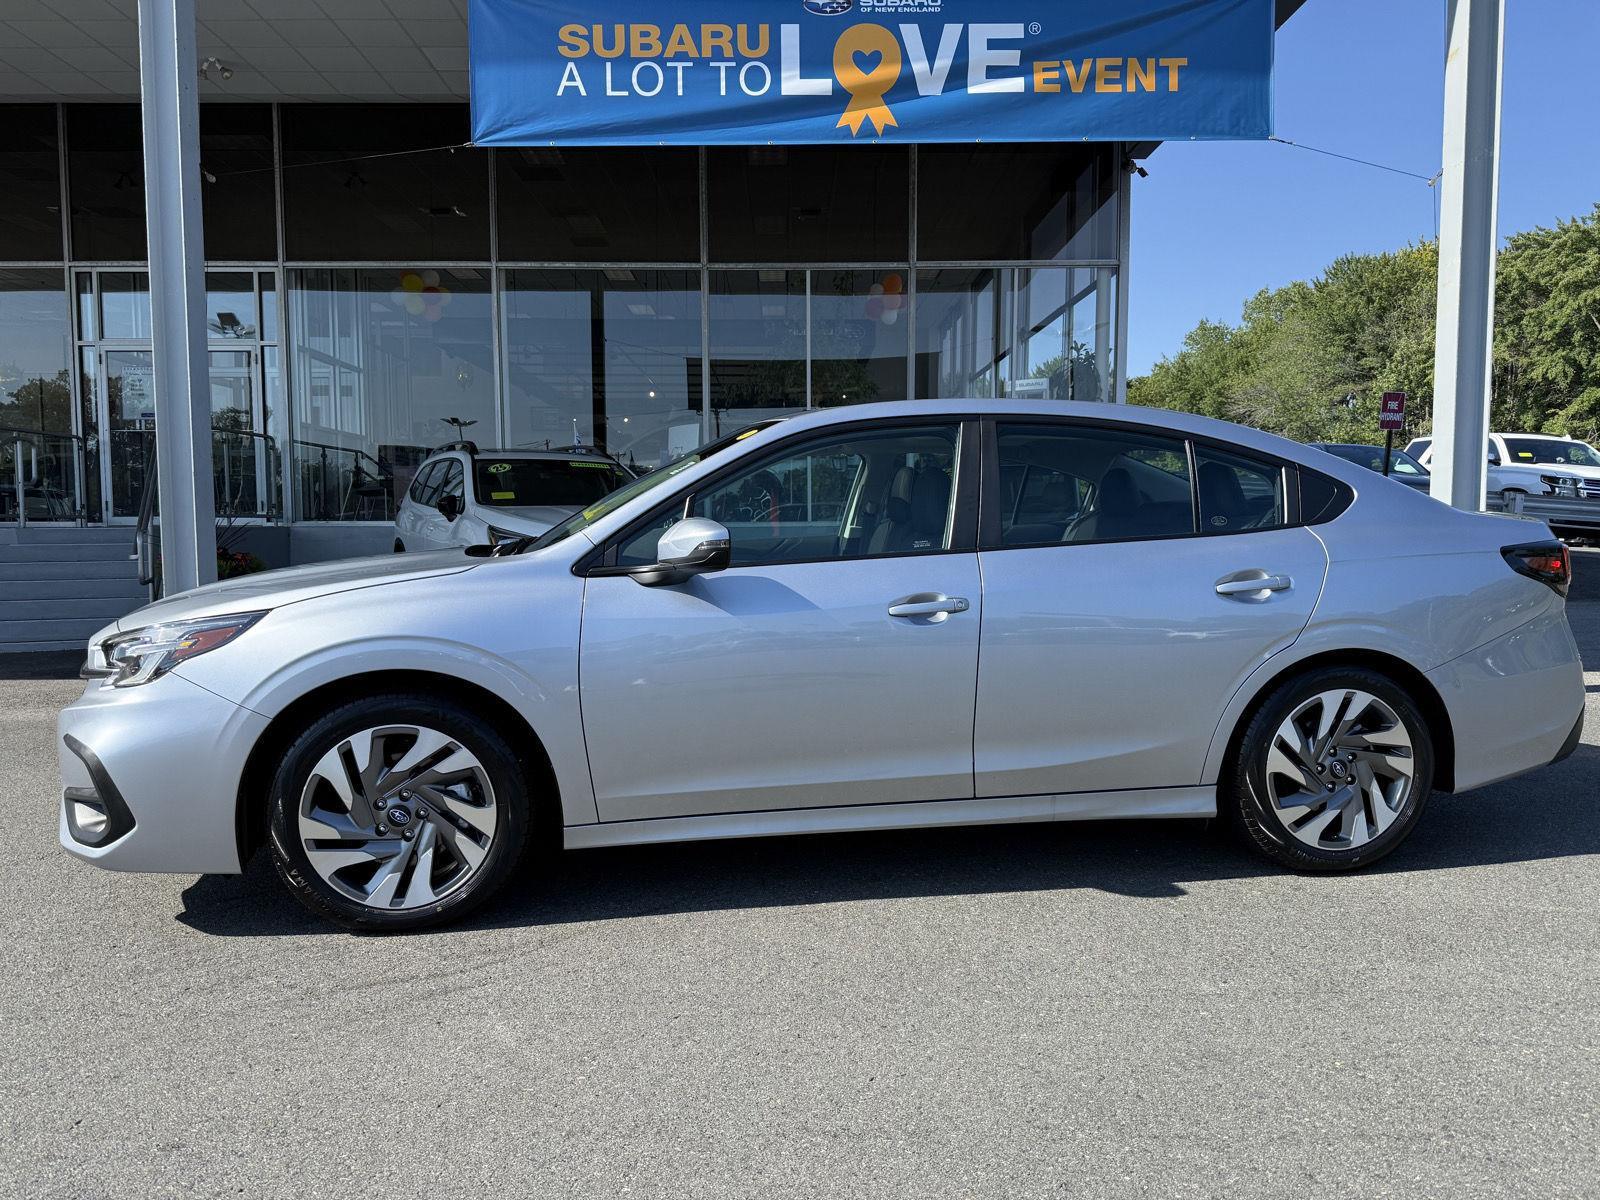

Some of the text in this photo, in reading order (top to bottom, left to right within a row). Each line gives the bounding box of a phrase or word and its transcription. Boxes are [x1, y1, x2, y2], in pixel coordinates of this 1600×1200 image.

[557, 24, 770, 58] SUBARU
[557, 61, 588, 96] A
[606, 61, 694, 96] LOT
[709, 61, 772, 96] TO
[1033, 57, 1188, 93] EVENT
